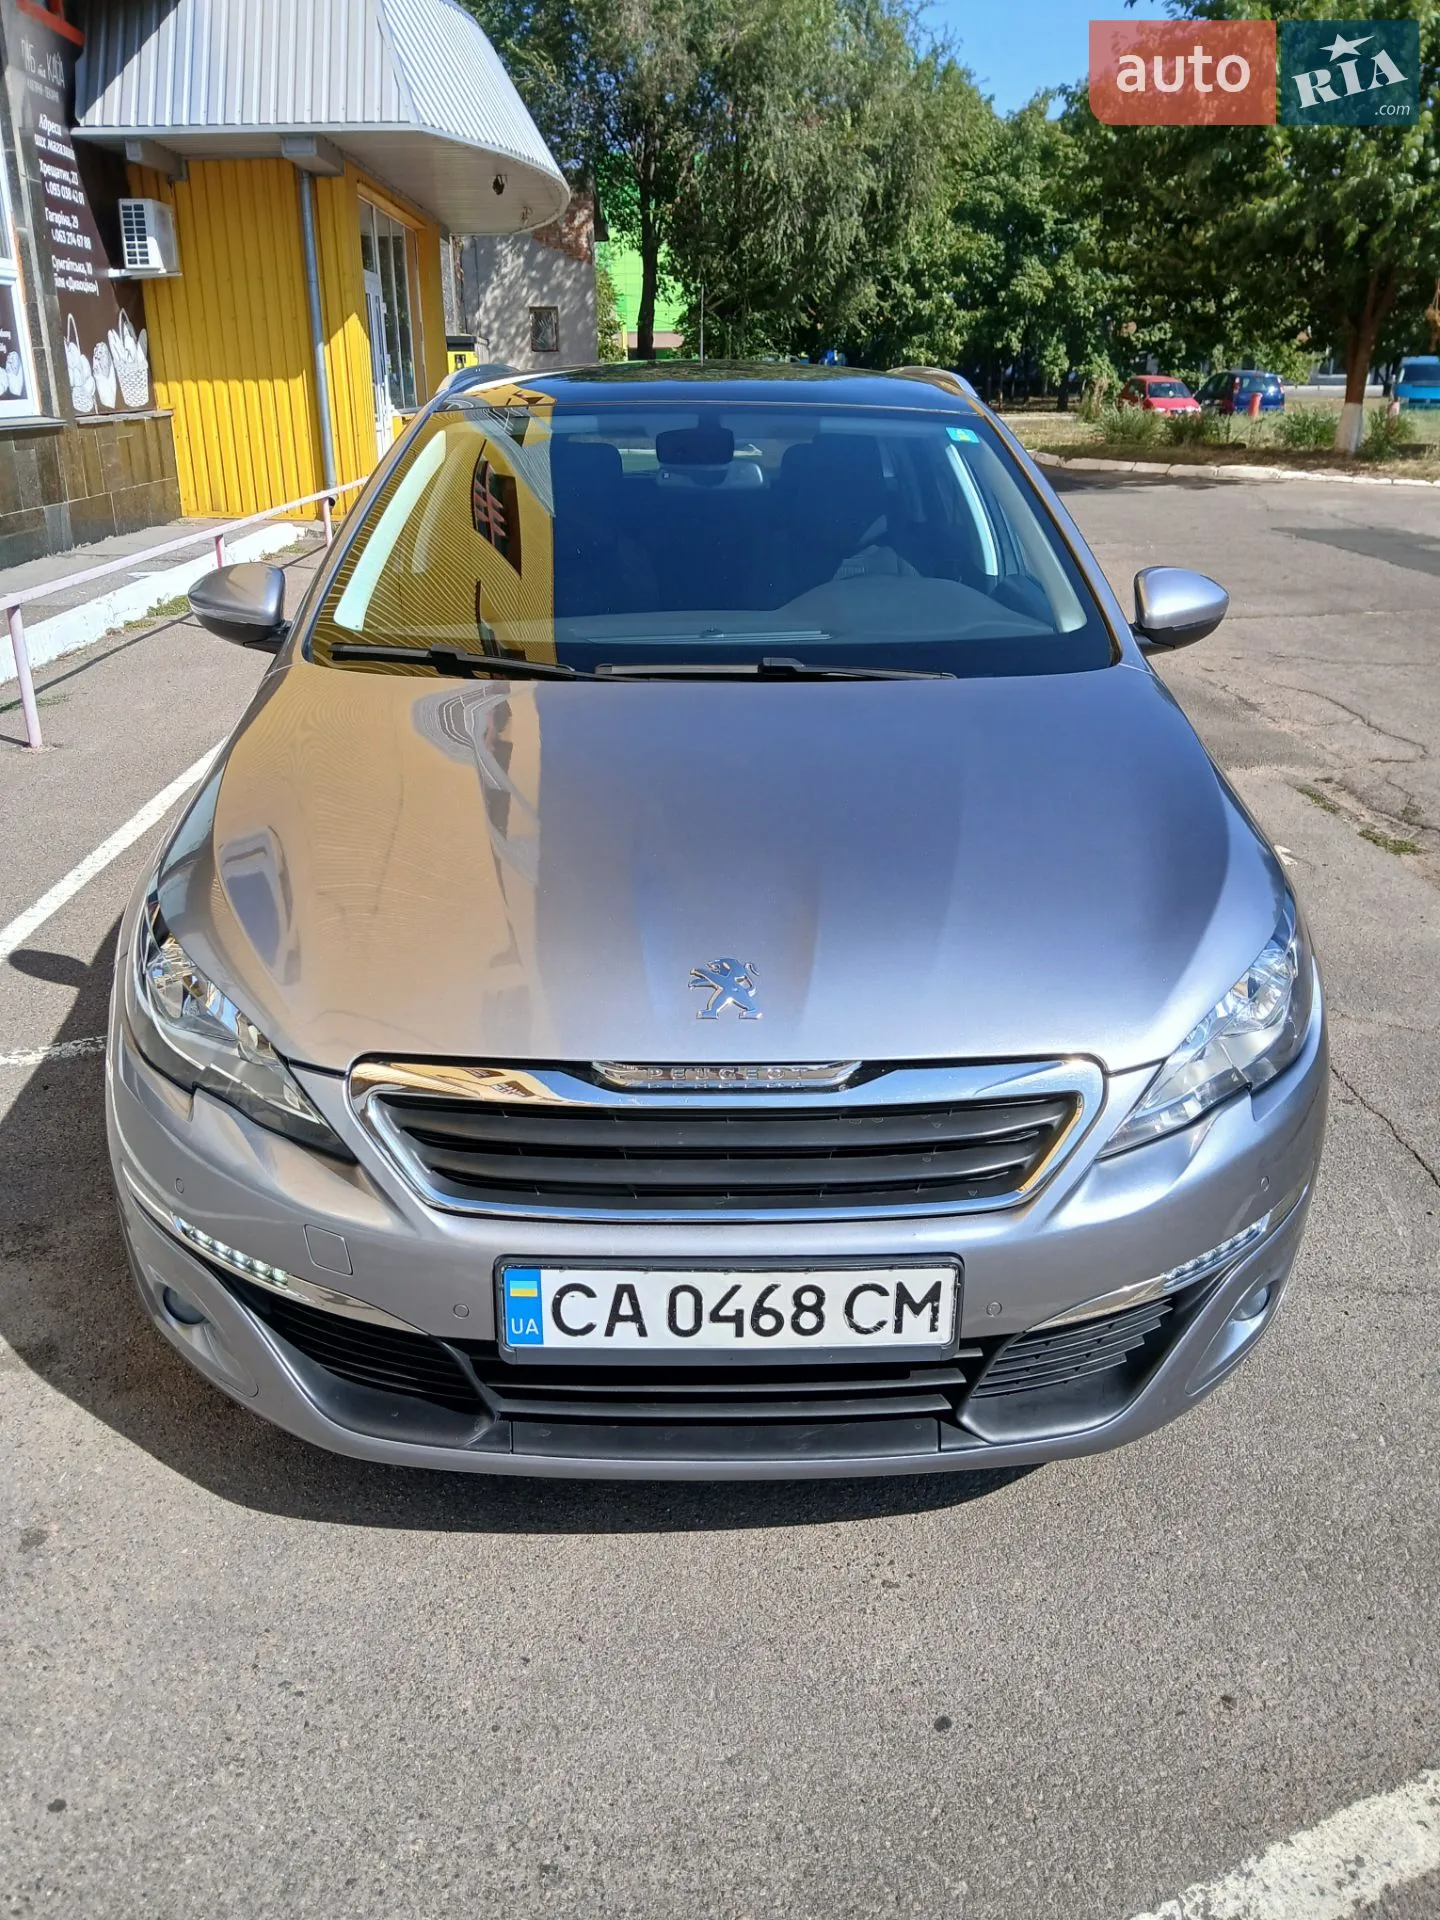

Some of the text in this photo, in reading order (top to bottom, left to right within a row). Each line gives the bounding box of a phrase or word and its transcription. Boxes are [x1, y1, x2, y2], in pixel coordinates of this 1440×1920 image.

[39, 112, 62, 136] Адреси
[551, 1280, 943, 1338] CA 0468 CM
[511, 1317, 539, 1336] UA
